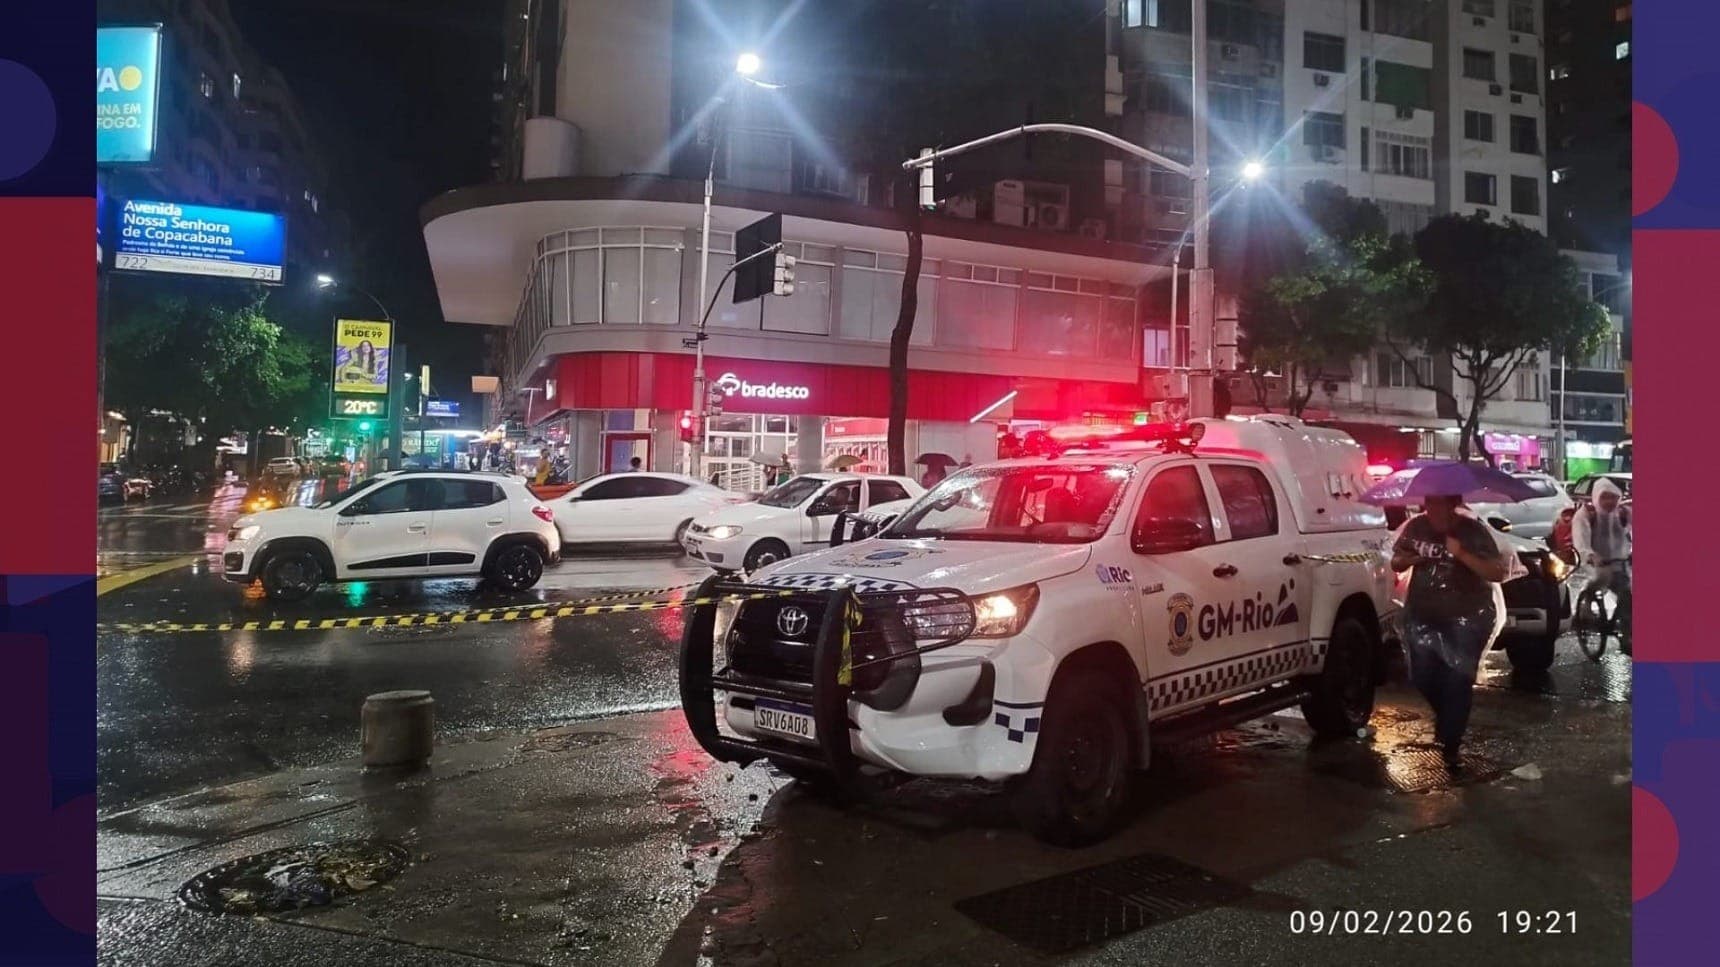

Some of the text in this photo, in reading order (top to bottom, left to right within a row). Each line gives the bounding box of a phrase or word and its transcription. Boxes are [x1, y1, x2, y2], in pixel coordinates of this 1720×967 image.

[97, 67, 120, 93] A
[123, 103, 142, 114] EM
[124, 200, 182, 217] Avenida
[124, 213, 230, 234] Nossa Senhora
[122, 226, 141, 238] de
[145, 227, 232, 246] Copacabana
[121, 256, 148, 269] 722
[250, 267, 275, 280] 734
[344, 329, 383, 338] PEDE 99
[741, 380, 809, 399] bradesco
[1198, 591, 1274, 641] GM-Rio
[760, 709, 808, 735] SRV6A08
